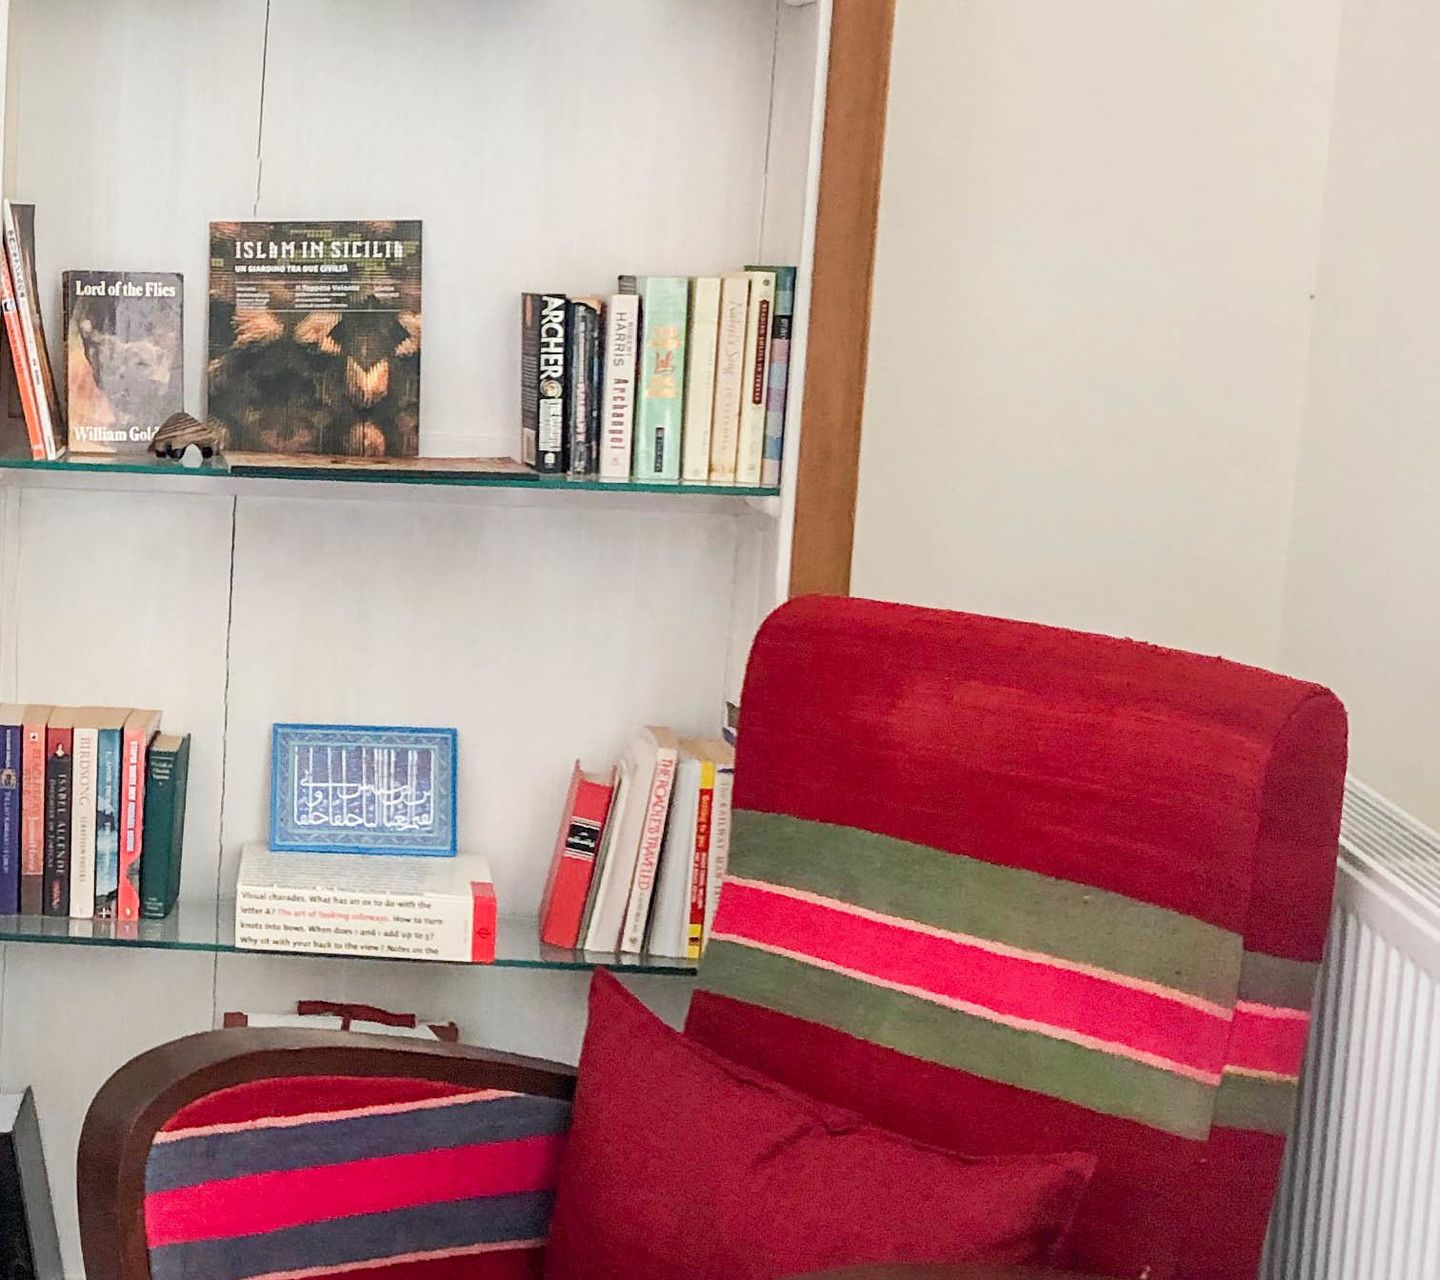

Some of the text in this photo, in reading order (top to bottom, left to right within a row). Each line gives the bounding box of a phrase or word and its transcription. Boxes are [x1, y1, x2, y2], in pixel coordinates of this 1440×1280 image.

[235, 241, 404, 259] ISLAM IN SICILIA
[76, 280, 176, 298] Lord of the Flies
[541, 295, 563, 380] ARCHER
[612, 311, 626, 367] HARRIS
[607, 377, 628, 449] Archangel
[74, 425, 127, 441] William
[79, 736, 90, 805] BIRDSONG
[55, 773, 66, 873] ISABEL ALLENDE
[241, 891, 265, 900] Visual
[268, 893, 306, 903] charades.
[309, 895, 331, 904] What
[333, 896, 347, 905] has
[374, 899, 382, 907] to
[384, 899, 395, 907] do
[397, 900, 415, 908] with
[418, 900, 432, 909] the
[241, 906, 262, 916] letter
[278, 908, 291, 916] The
[293, 909, 306, 917] art
[308, 910, 316, 918] of
[414, 916, 422, 924] to
[424, 917, 443, 925] turn
[241, 921, 262, 931] knots
[265, 922, 281, 931] into
[308, 925, 332, 934] When
[334, 926, 353, 935] does
[360, 928, 376, 936] and
[383, 929, 399, 937] add
[401, 931, 412, 940] up
[414, 931, 423, 939] to
[241, 935, 258, 946] Why
[260, 937, 270, 945] sit
[272, 937, 291, 946] with
[293, 940, 311, 949] your
[313, 940, 331, 949] back
[334, 941, 342, 949] to
[345, 941, 358, 950] the
[387, 944, 410, 953] Notes
[426, 947, 439, 955] the
